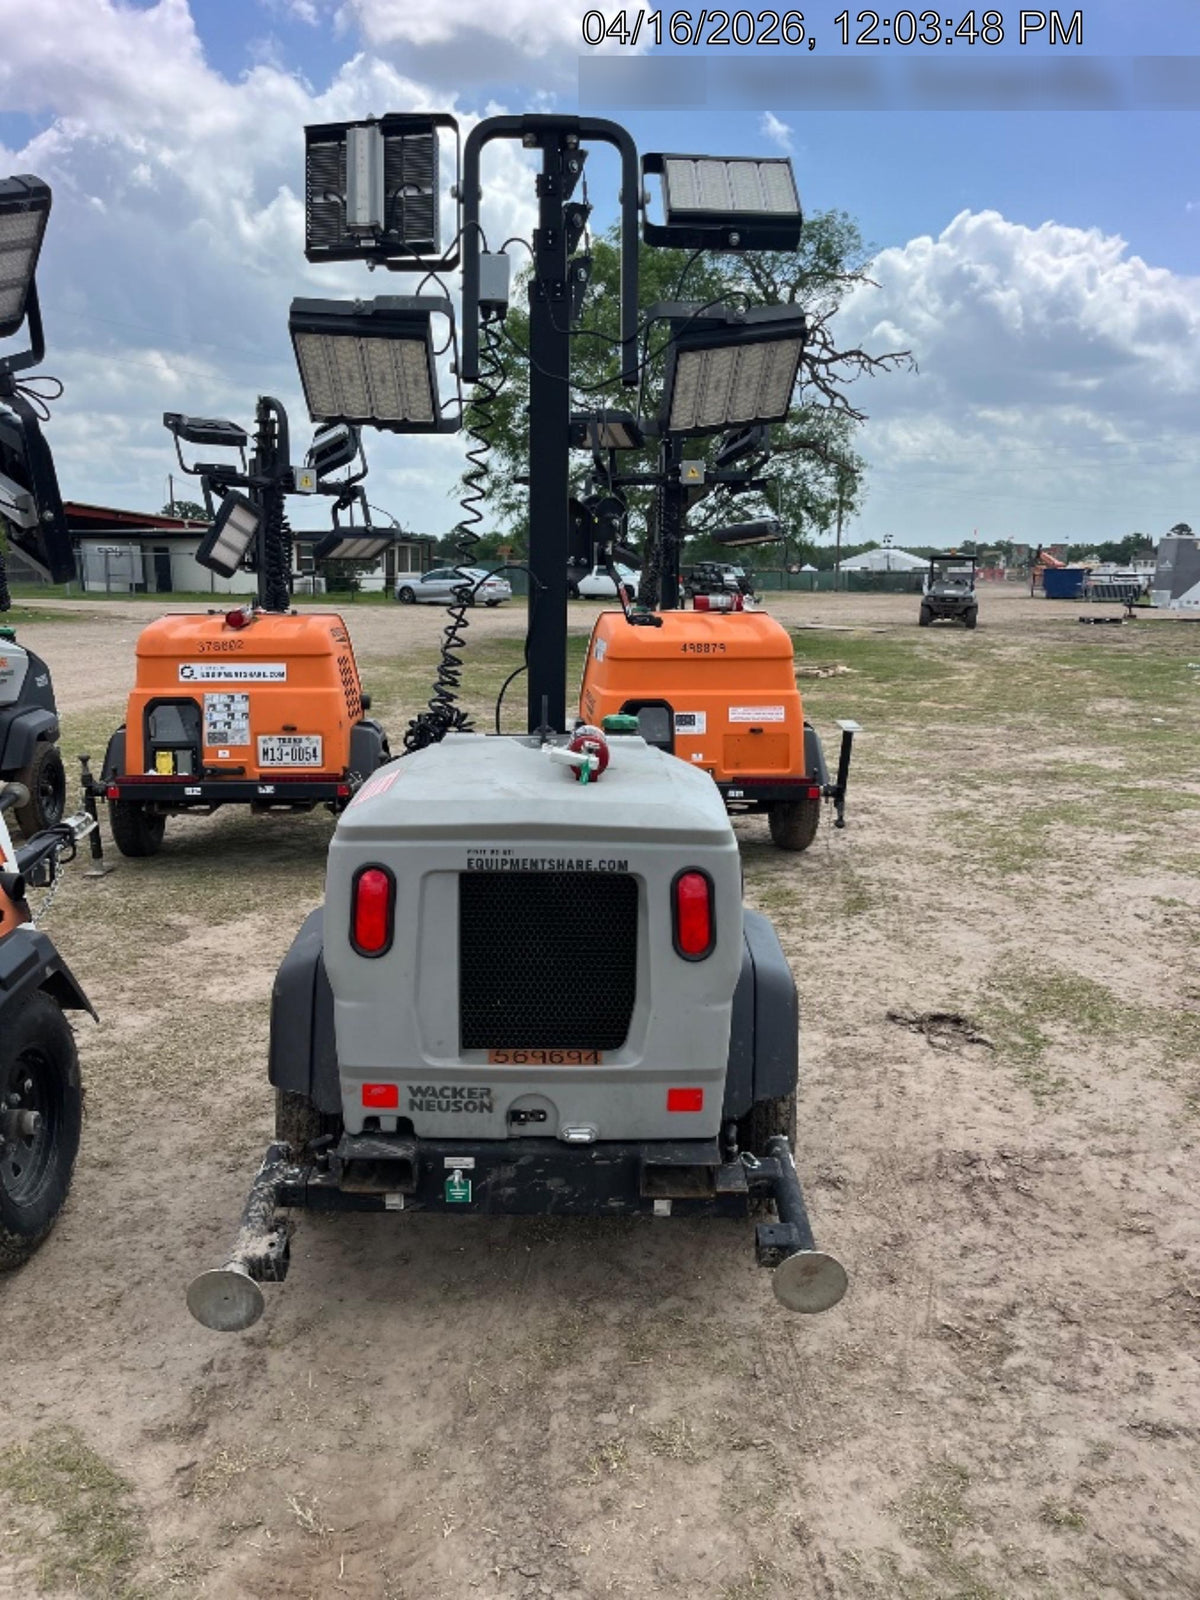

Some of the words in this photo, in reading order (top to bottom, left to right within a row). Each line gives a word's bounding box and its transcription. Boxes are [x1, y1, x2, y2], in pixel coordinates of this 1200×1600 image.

[681, 643, 726, 653] 498879
[466, 858, 629, 872] EQUIPMENTSHARE.COM
[494, 1050, 599, 1064] 569694
[407, 1085, 492, 1099] WACKER
[409, 1099, 494, 1113] NEUSON
